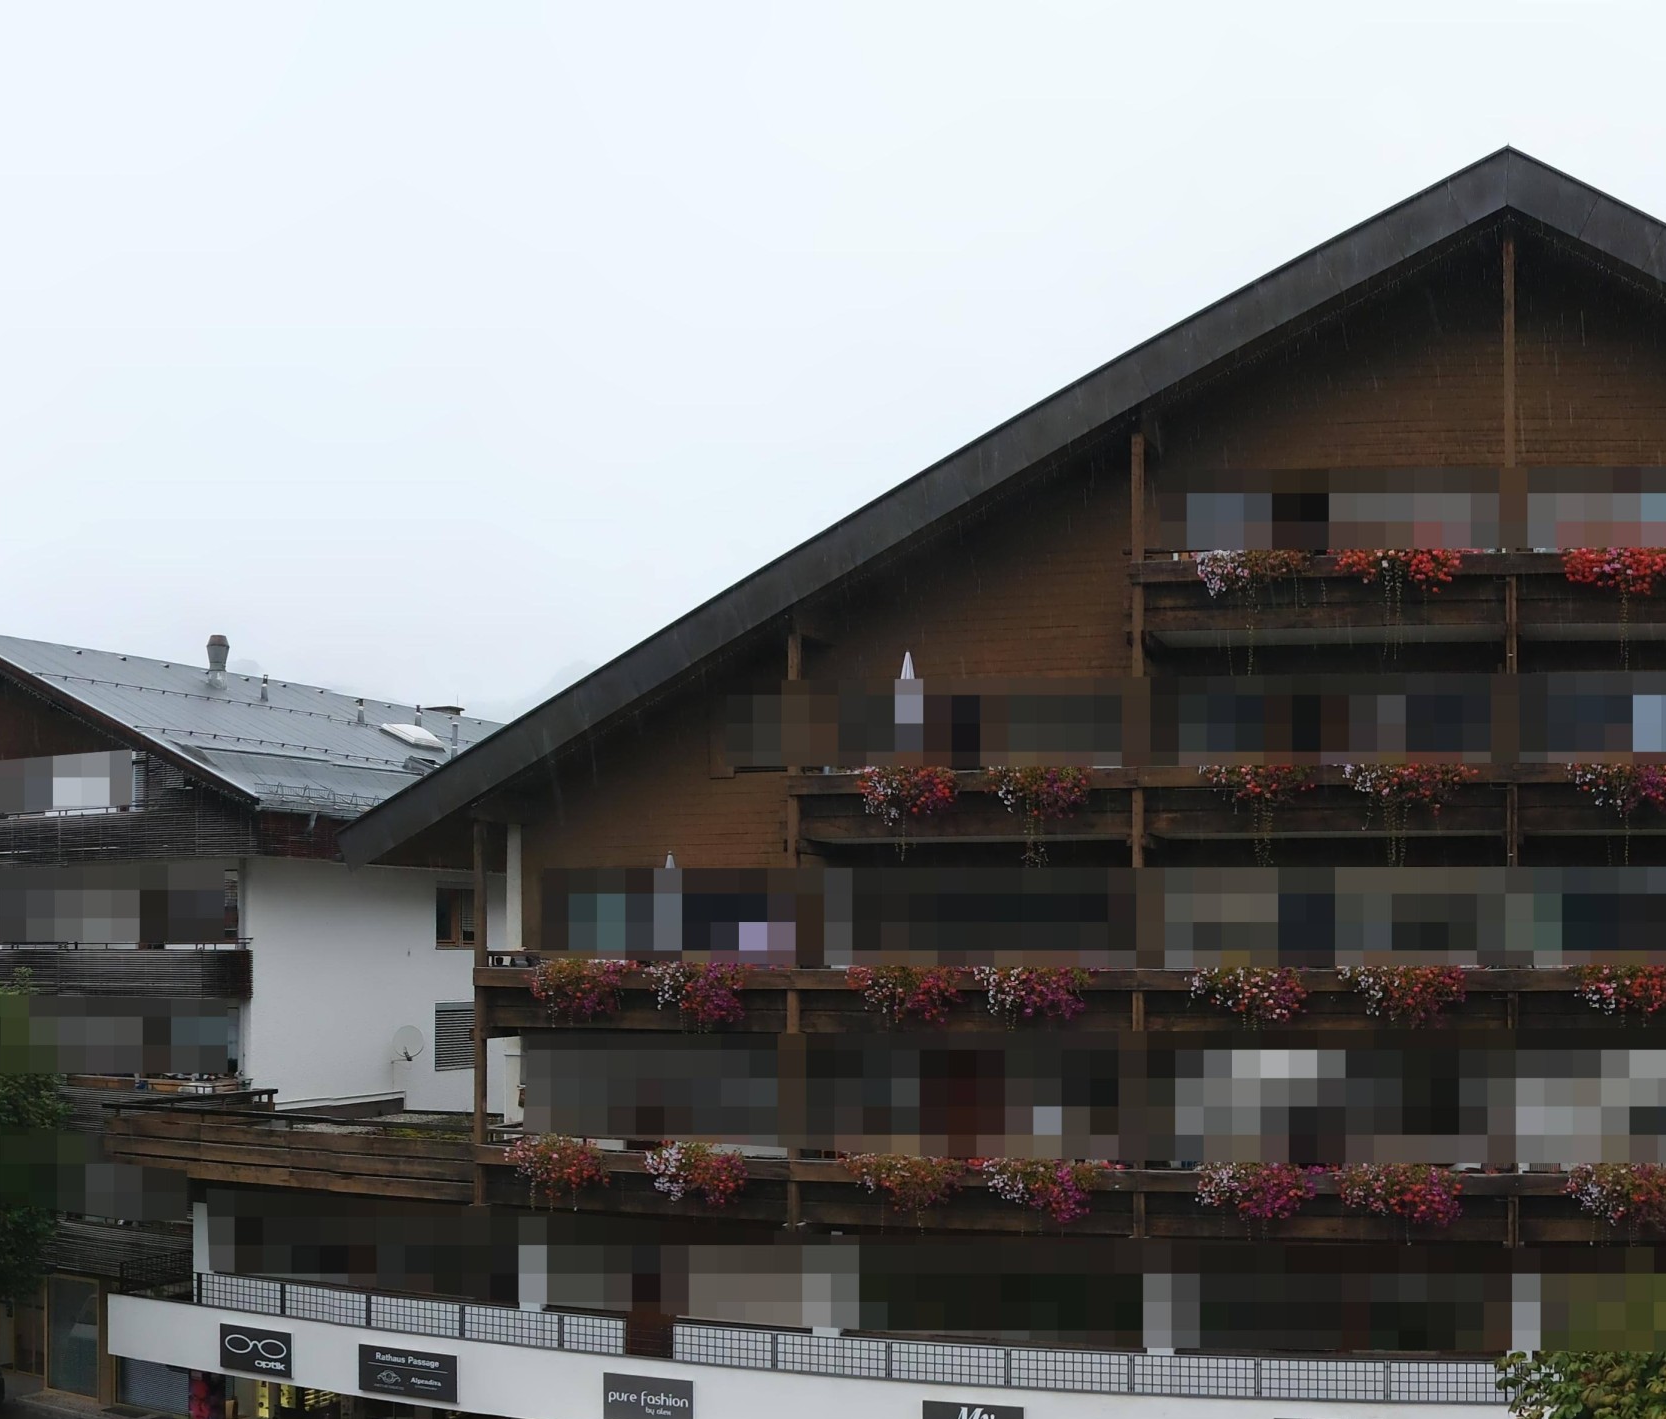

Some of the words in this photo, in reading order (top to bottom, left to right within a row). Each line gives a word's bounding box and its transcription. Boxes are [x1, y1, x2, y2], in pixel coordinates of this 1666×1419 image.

[254, 1359, 285, 1371] optik
[375, 1352, 405, 1364] Rathaus
[408, 1355, 439, 1368] Passage
[608, 1391, 637, 1403] pure
[641, 1391, 689, 1408] fashion
[645, 1407, 654, 1415] by
